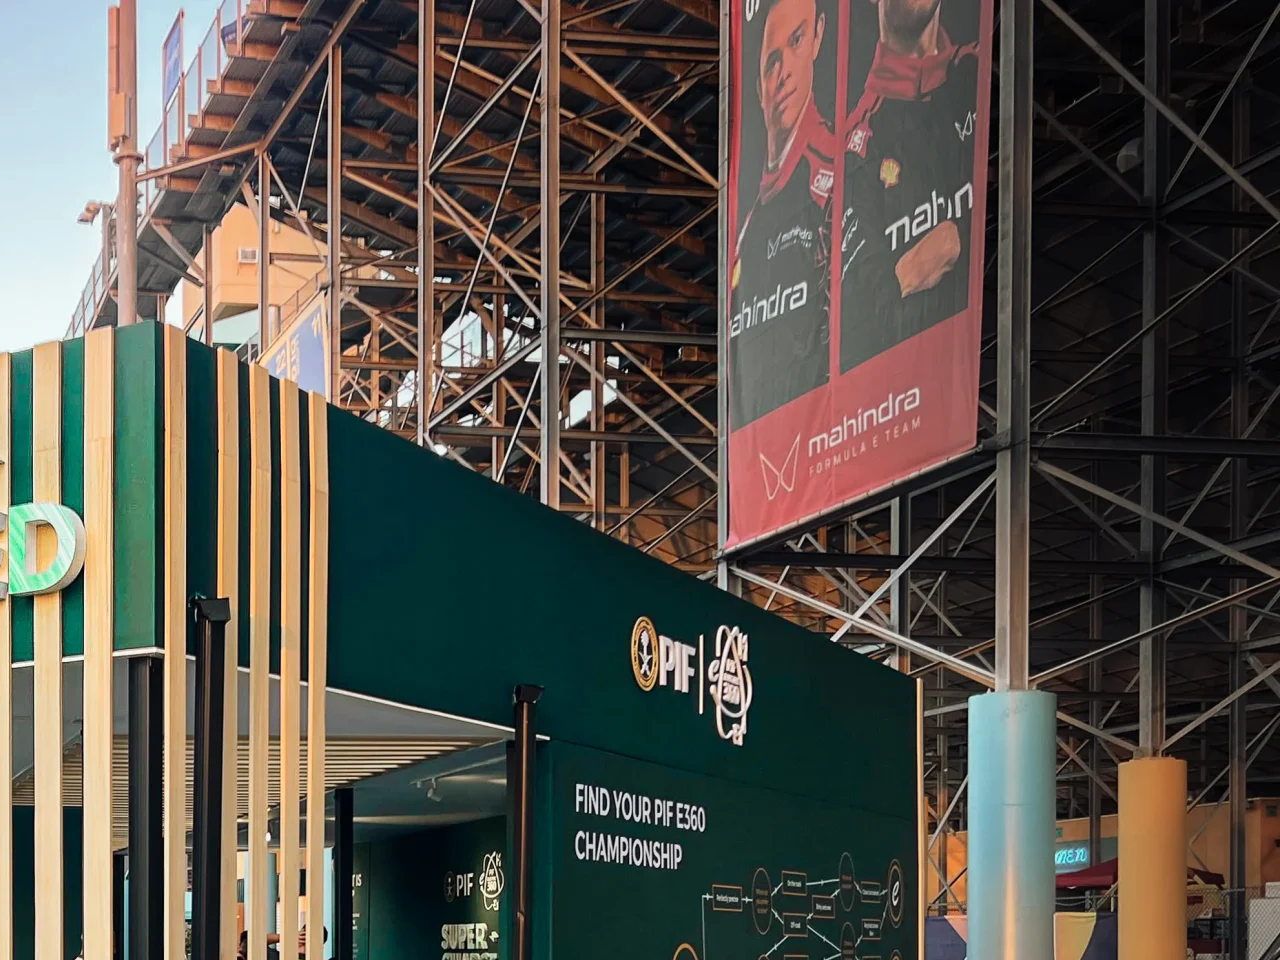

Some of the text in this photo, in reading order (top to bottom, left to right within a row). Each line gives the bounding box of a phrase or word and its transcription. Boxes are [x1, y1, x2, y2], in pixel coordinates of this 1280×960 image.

[808, 387, 920, 457] mahindra
[809, 415, 921, 478] FORMULA E TEAM
[658, 635, 697, 694] PIF
[575, 783, 706, 832] FIND YOUR PIF E360
[575, 830, 683, 870] CHAMPIONSHIP
[456, 872, 474, 897] PIF
[441, 923, 488, 950] SUPER
